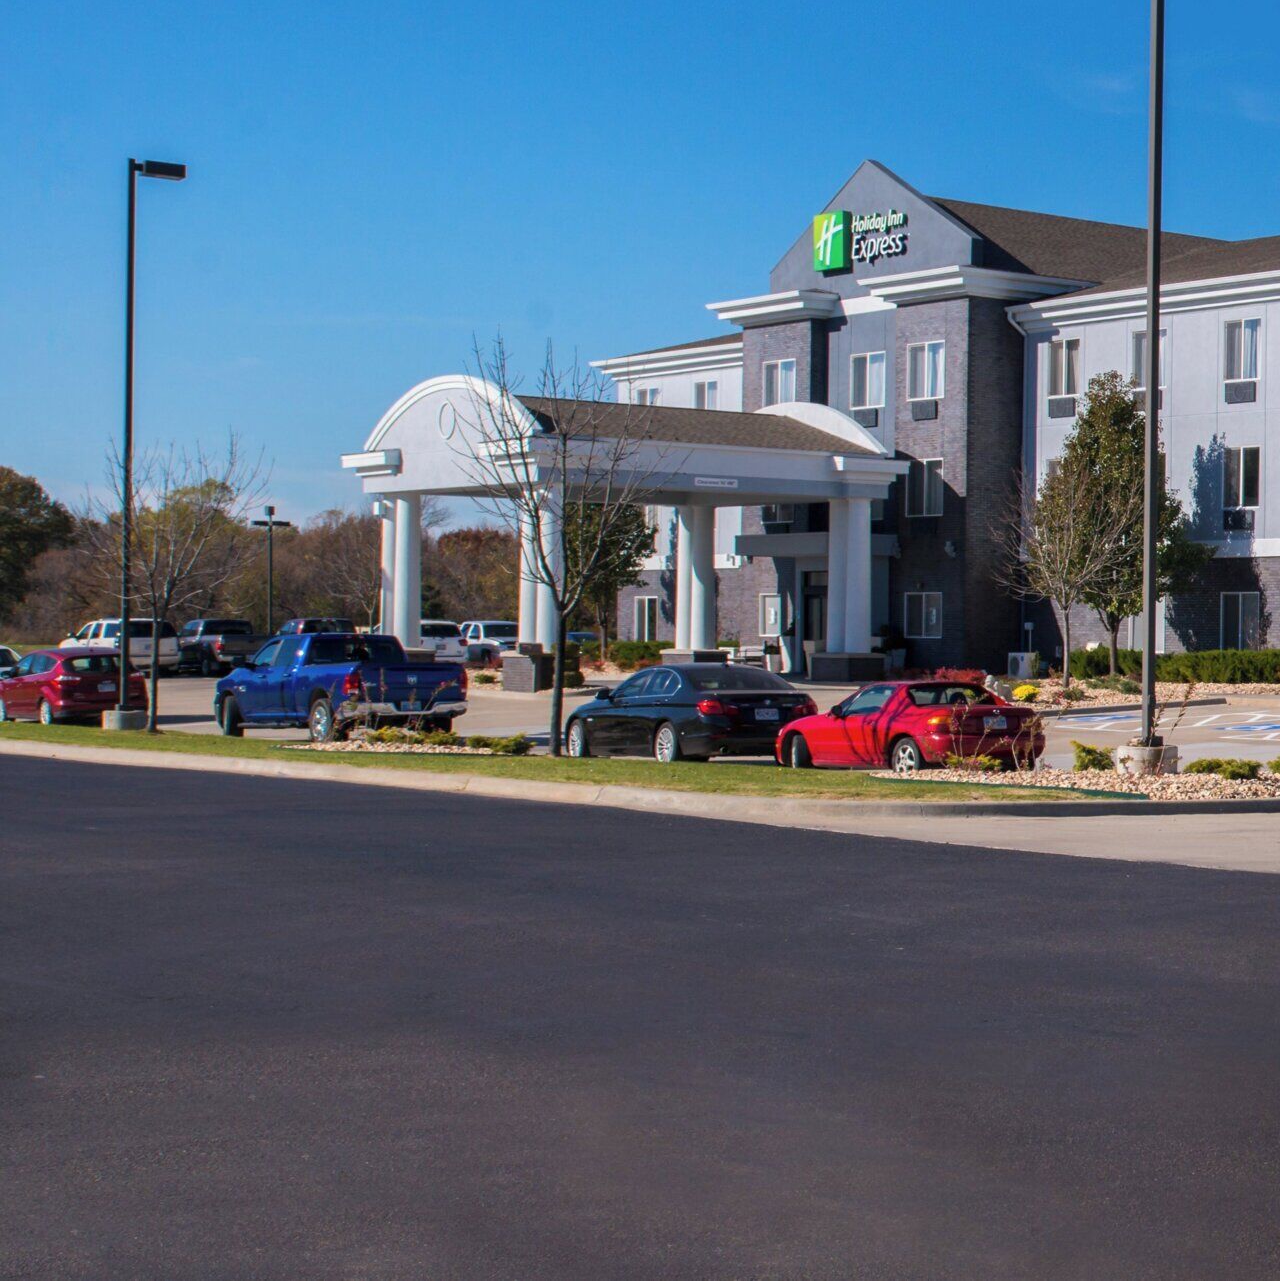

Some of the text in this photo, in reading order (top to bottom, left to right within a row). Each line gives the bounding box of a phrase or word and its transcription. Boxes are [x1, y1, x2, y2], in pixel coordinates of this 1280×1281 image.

[852, 209, 904, 233] Holiday Inn
[851, 233, 904, 264] Express
